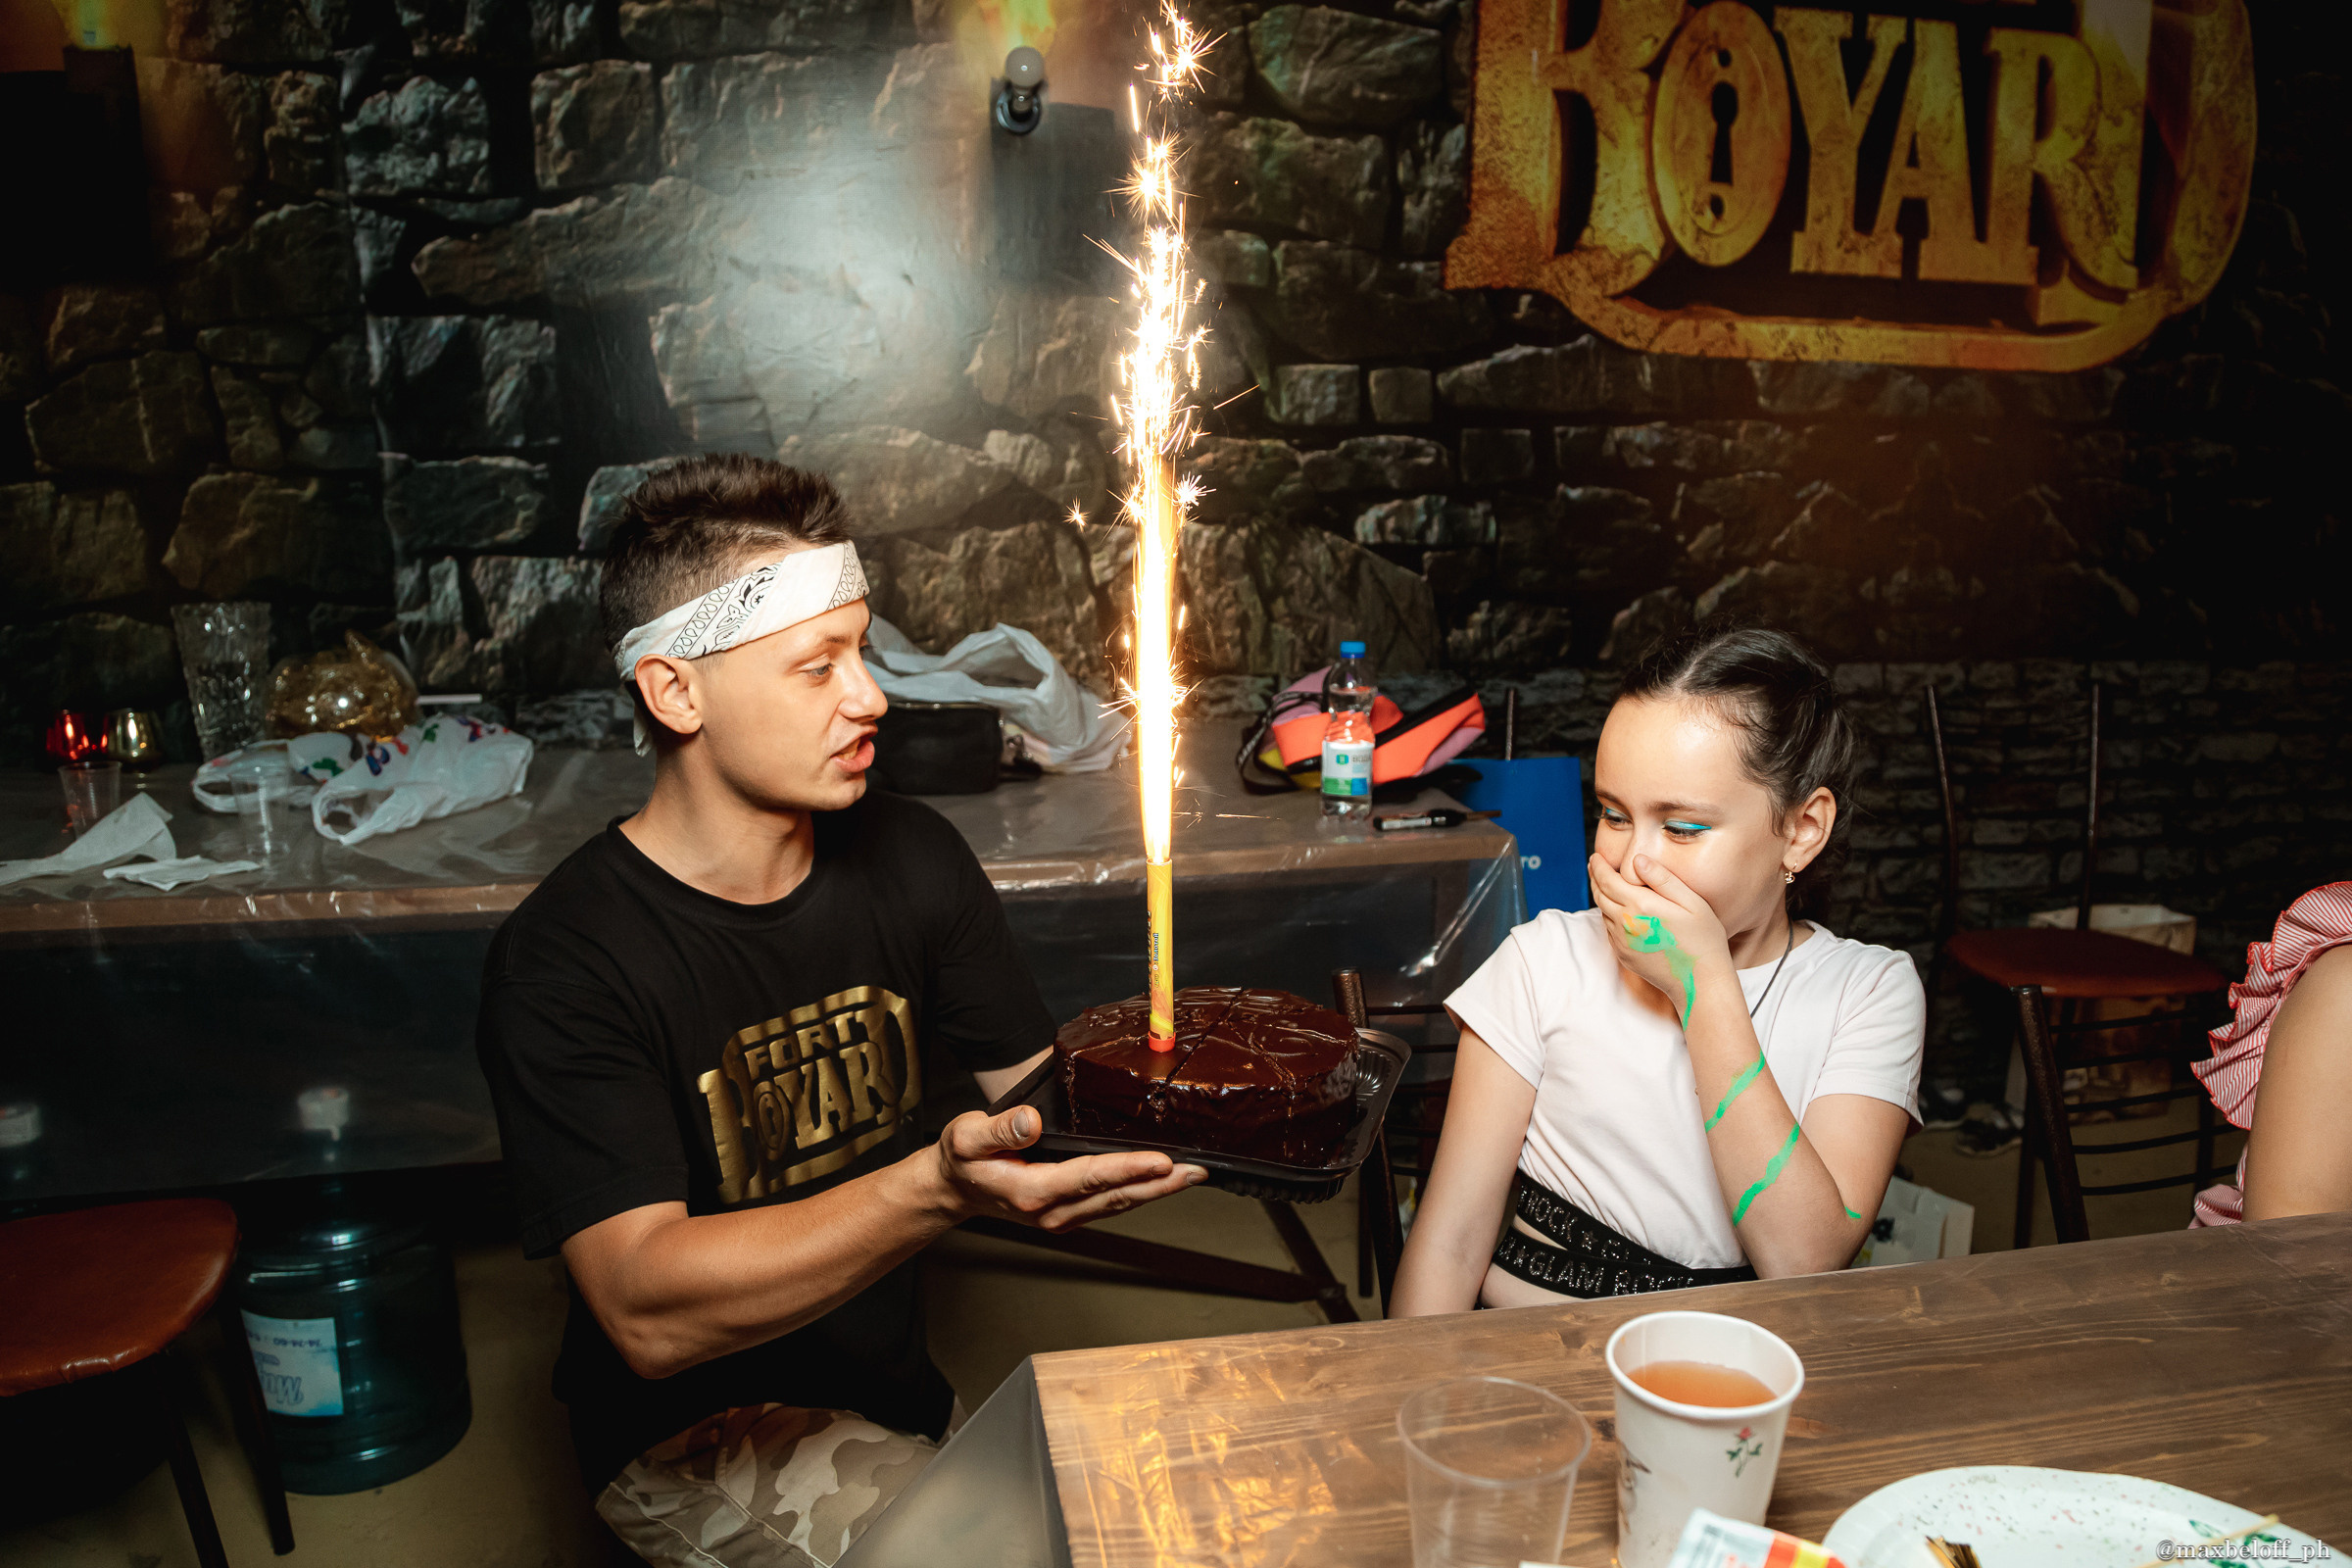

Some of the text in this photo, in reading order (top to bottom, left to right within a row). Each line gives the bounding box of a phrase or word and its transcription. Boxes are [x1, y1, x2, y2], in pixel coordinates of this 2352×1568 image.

[745, 1011, 856, 1080] FORT
[697, 988, 922, 1204] BOYARD
[1529, 1250, 1604, 1294] GLAM
